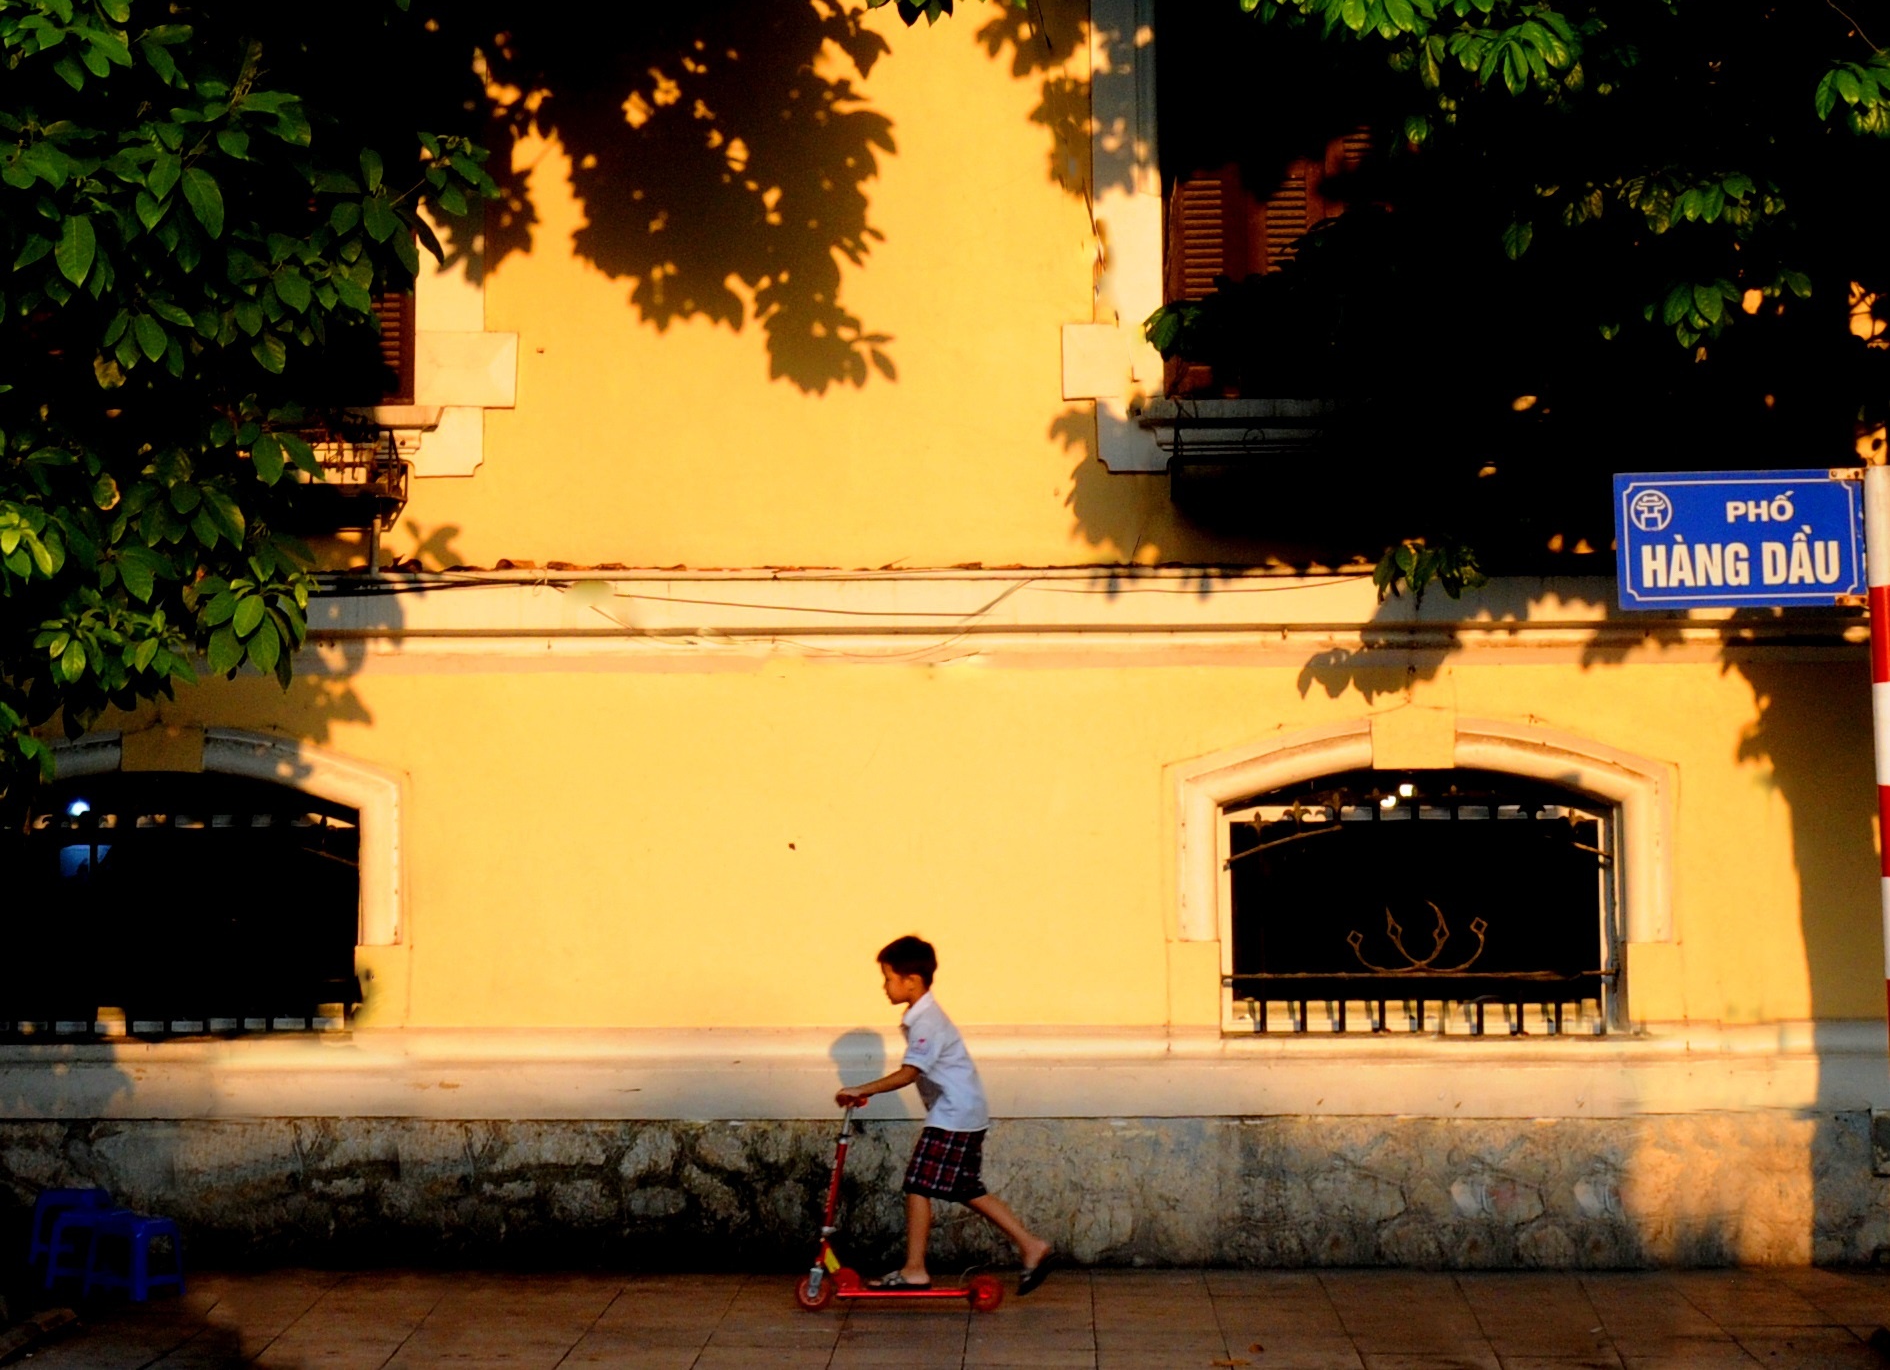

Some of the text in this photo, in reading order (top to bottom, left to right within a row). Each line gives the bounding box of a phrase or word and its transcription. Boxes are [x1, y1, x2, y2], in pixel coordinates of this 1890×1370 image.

[1725, 490, 1795, 523] PHỐ
[1641, 524, 1841, 589] HÀNG DẦU
